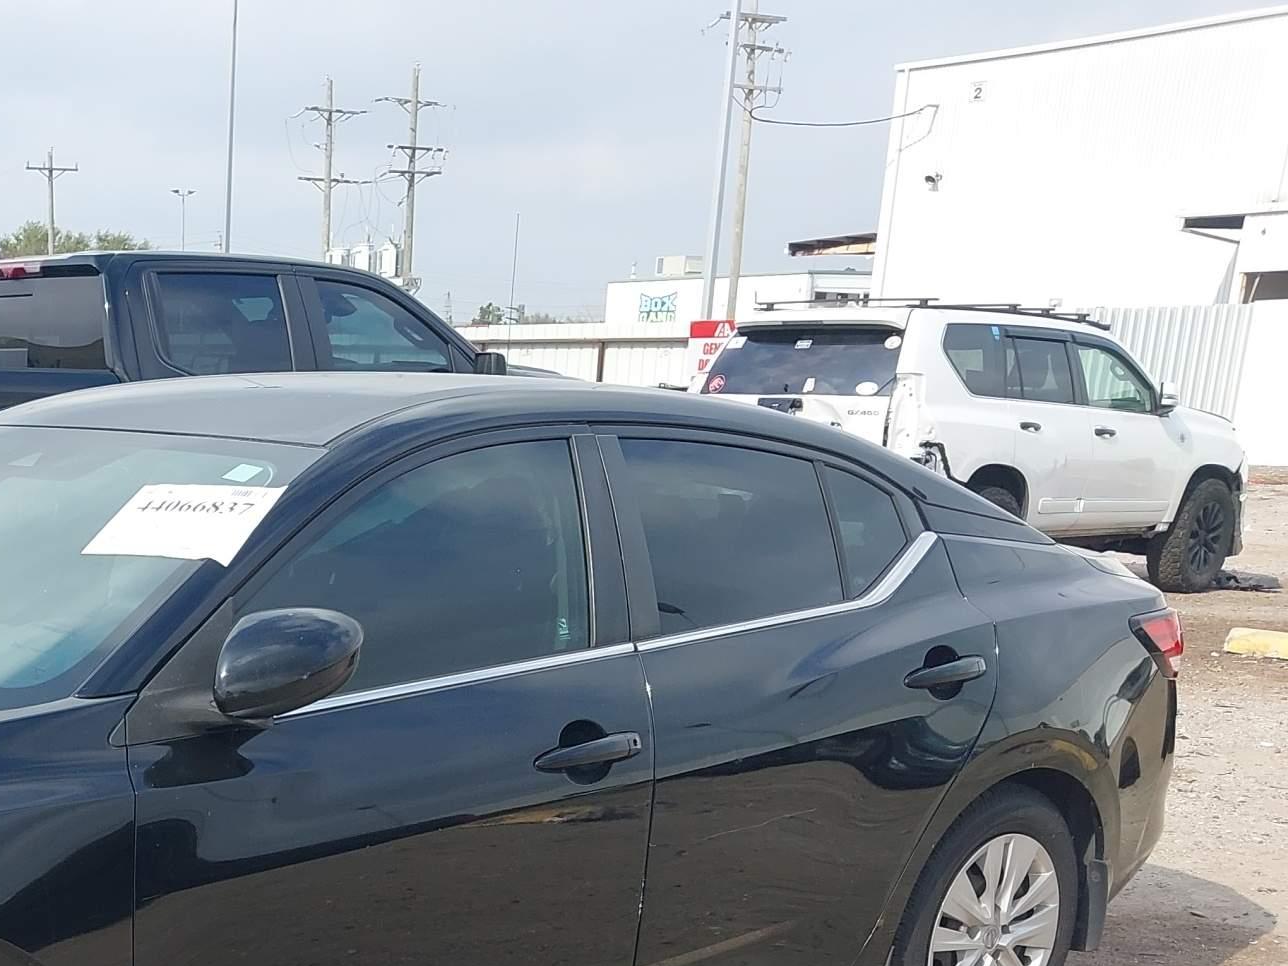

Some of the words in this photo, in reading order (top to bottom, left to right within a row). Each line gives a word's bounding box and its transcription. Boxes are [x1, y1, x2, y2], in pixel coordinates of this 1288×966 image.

[974, 87, 983, 99] 2
[639, 292, 677, 311] BOX
[137, 501, 255, 514] 44066837
